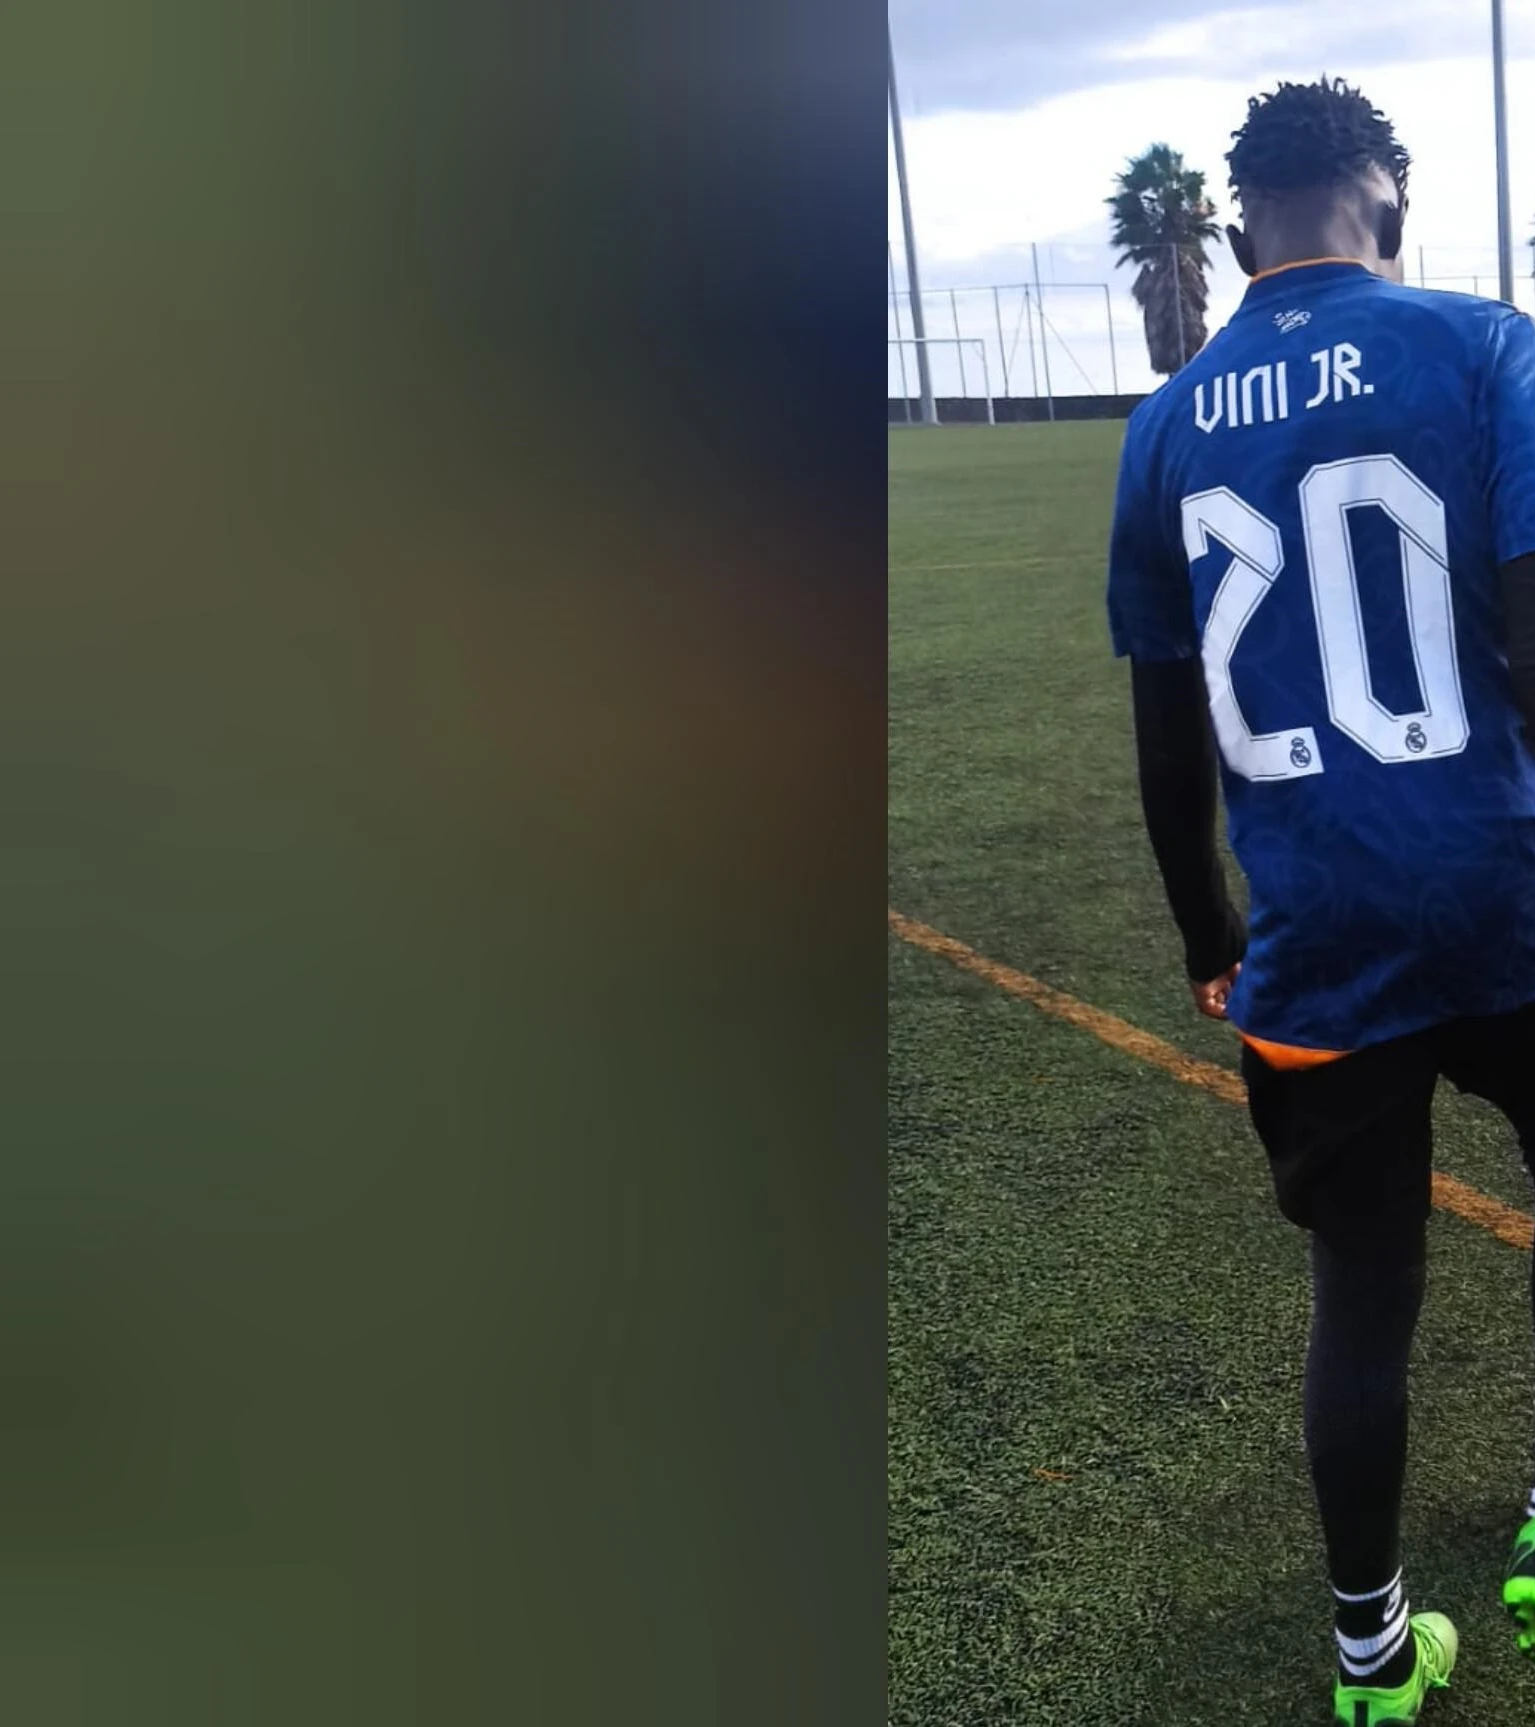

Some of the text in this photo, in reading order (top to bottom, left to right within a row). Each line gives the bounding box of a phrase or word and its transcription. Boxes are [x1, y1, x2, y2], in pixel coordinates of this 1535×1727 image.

[1195, 343, 1374, 433] VINI JR.
[1181, 454, 1470, 782] 20
